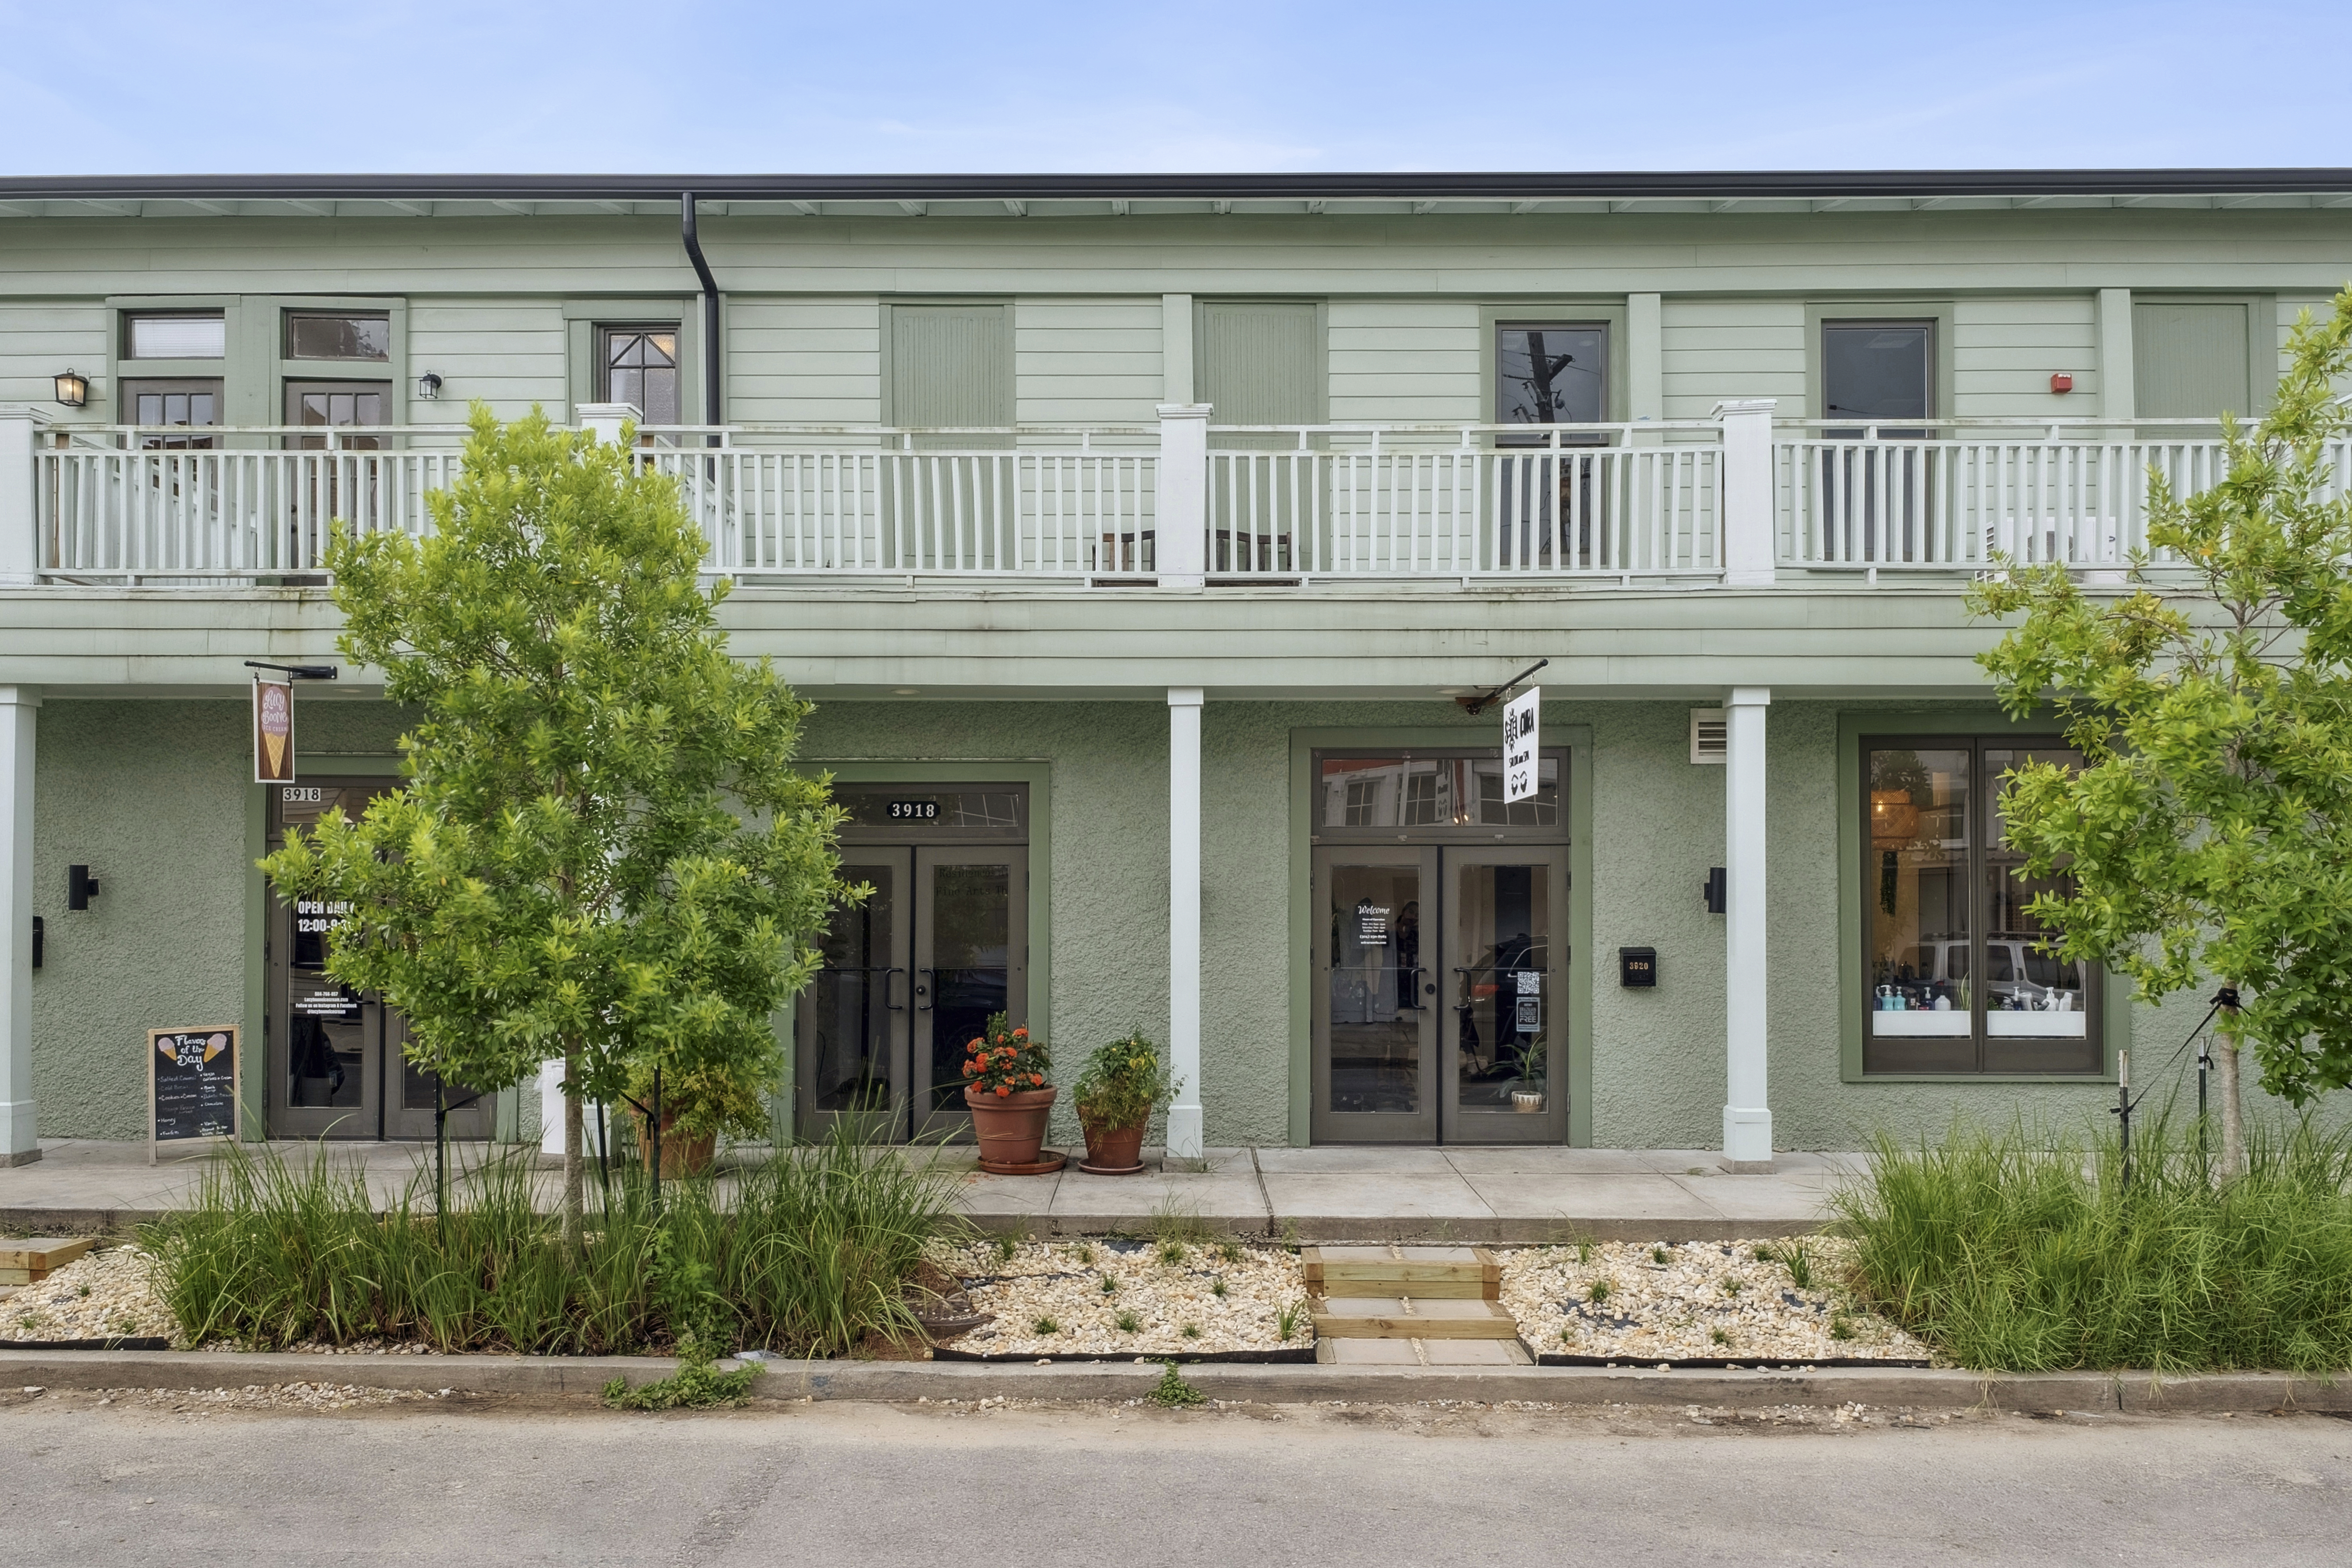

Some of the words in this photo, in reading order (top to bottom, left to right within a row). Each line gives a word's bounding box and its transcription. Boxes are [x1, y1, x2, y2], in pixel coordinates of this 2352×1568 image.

[1520, 707, 1534, 738] CURA
[284, 788, 319, 800] 3918
[892, 803, 934, 817] 3918
[967, 886, 991, 895] Arts
[298, 901, 324, 914] OPEN
[1358, 905, 1390, 915] Welcome
[175, 1035, 206, 1046] Flavors
[181, 1045, 190, 1054] of
[177, 1054, 203, 1071] Day
